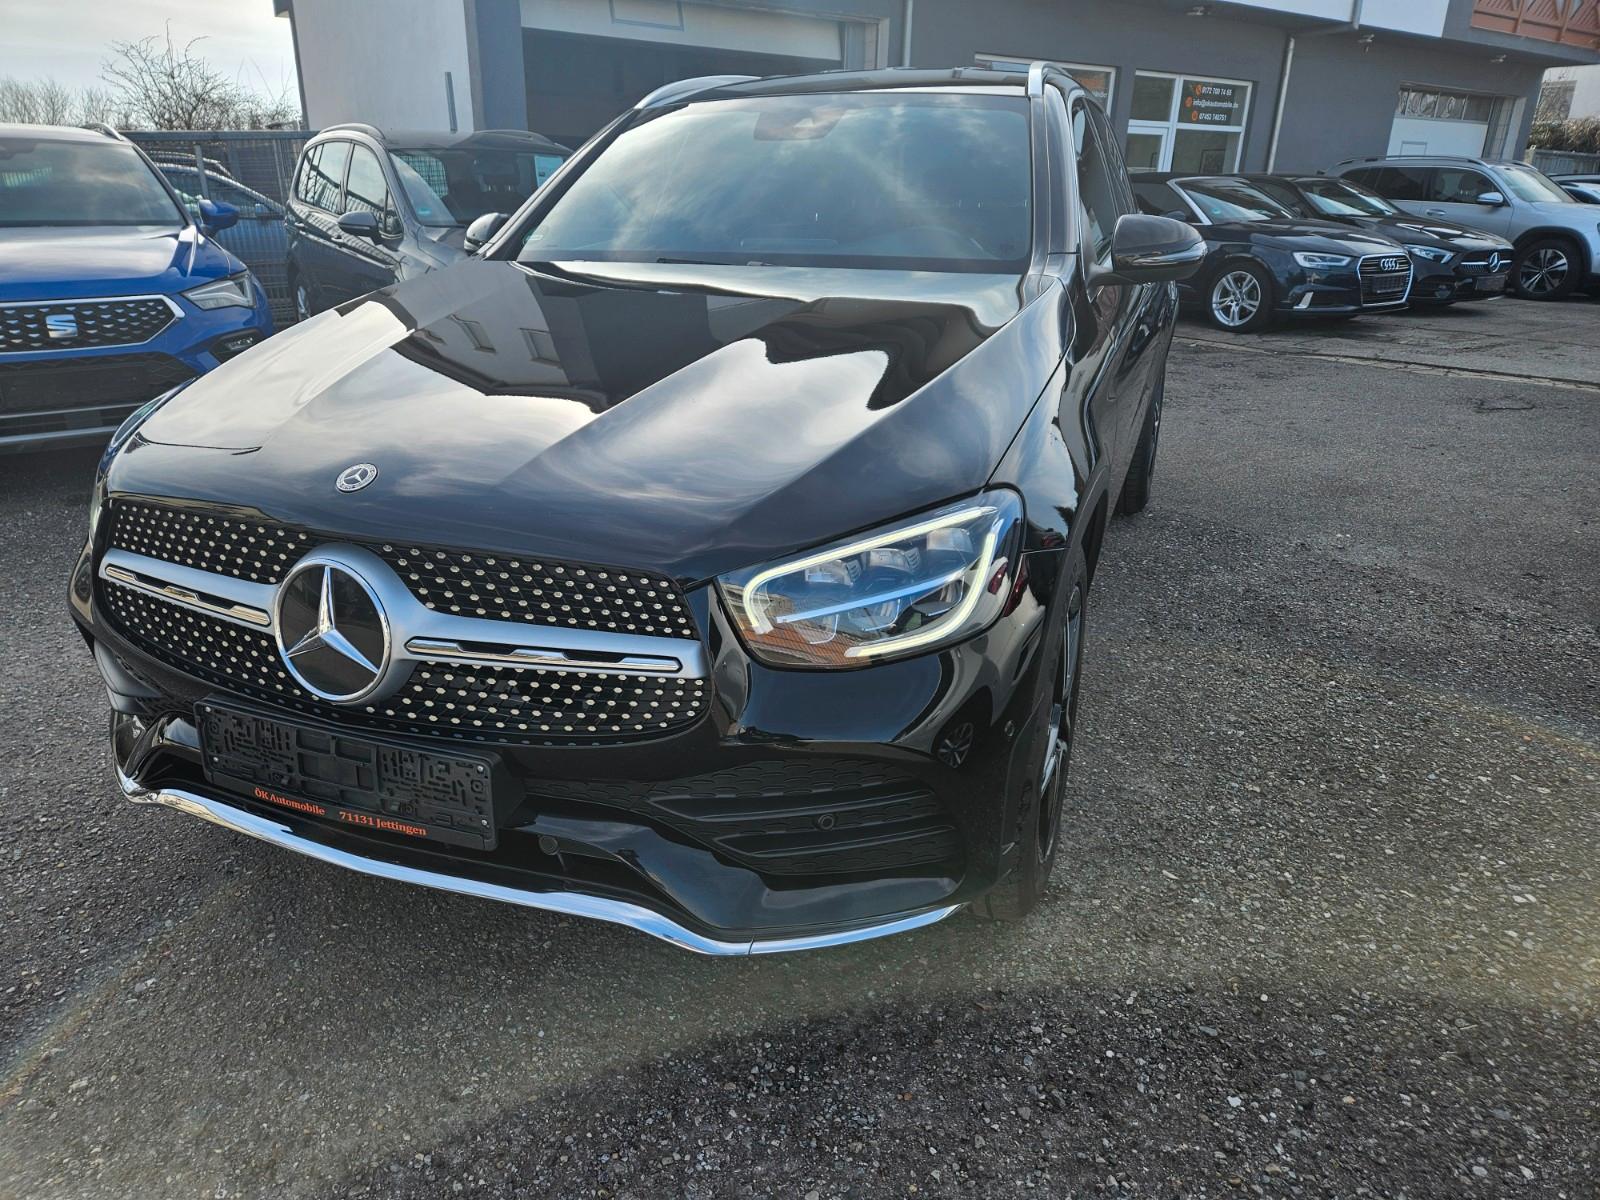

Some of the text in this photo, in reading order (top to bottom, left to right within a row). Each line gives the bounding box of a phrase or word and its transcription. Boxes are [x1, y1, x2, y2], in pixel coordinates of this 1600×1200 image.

[255, 787, 427, 836] ÖK Automobile 71131 Jettingen
